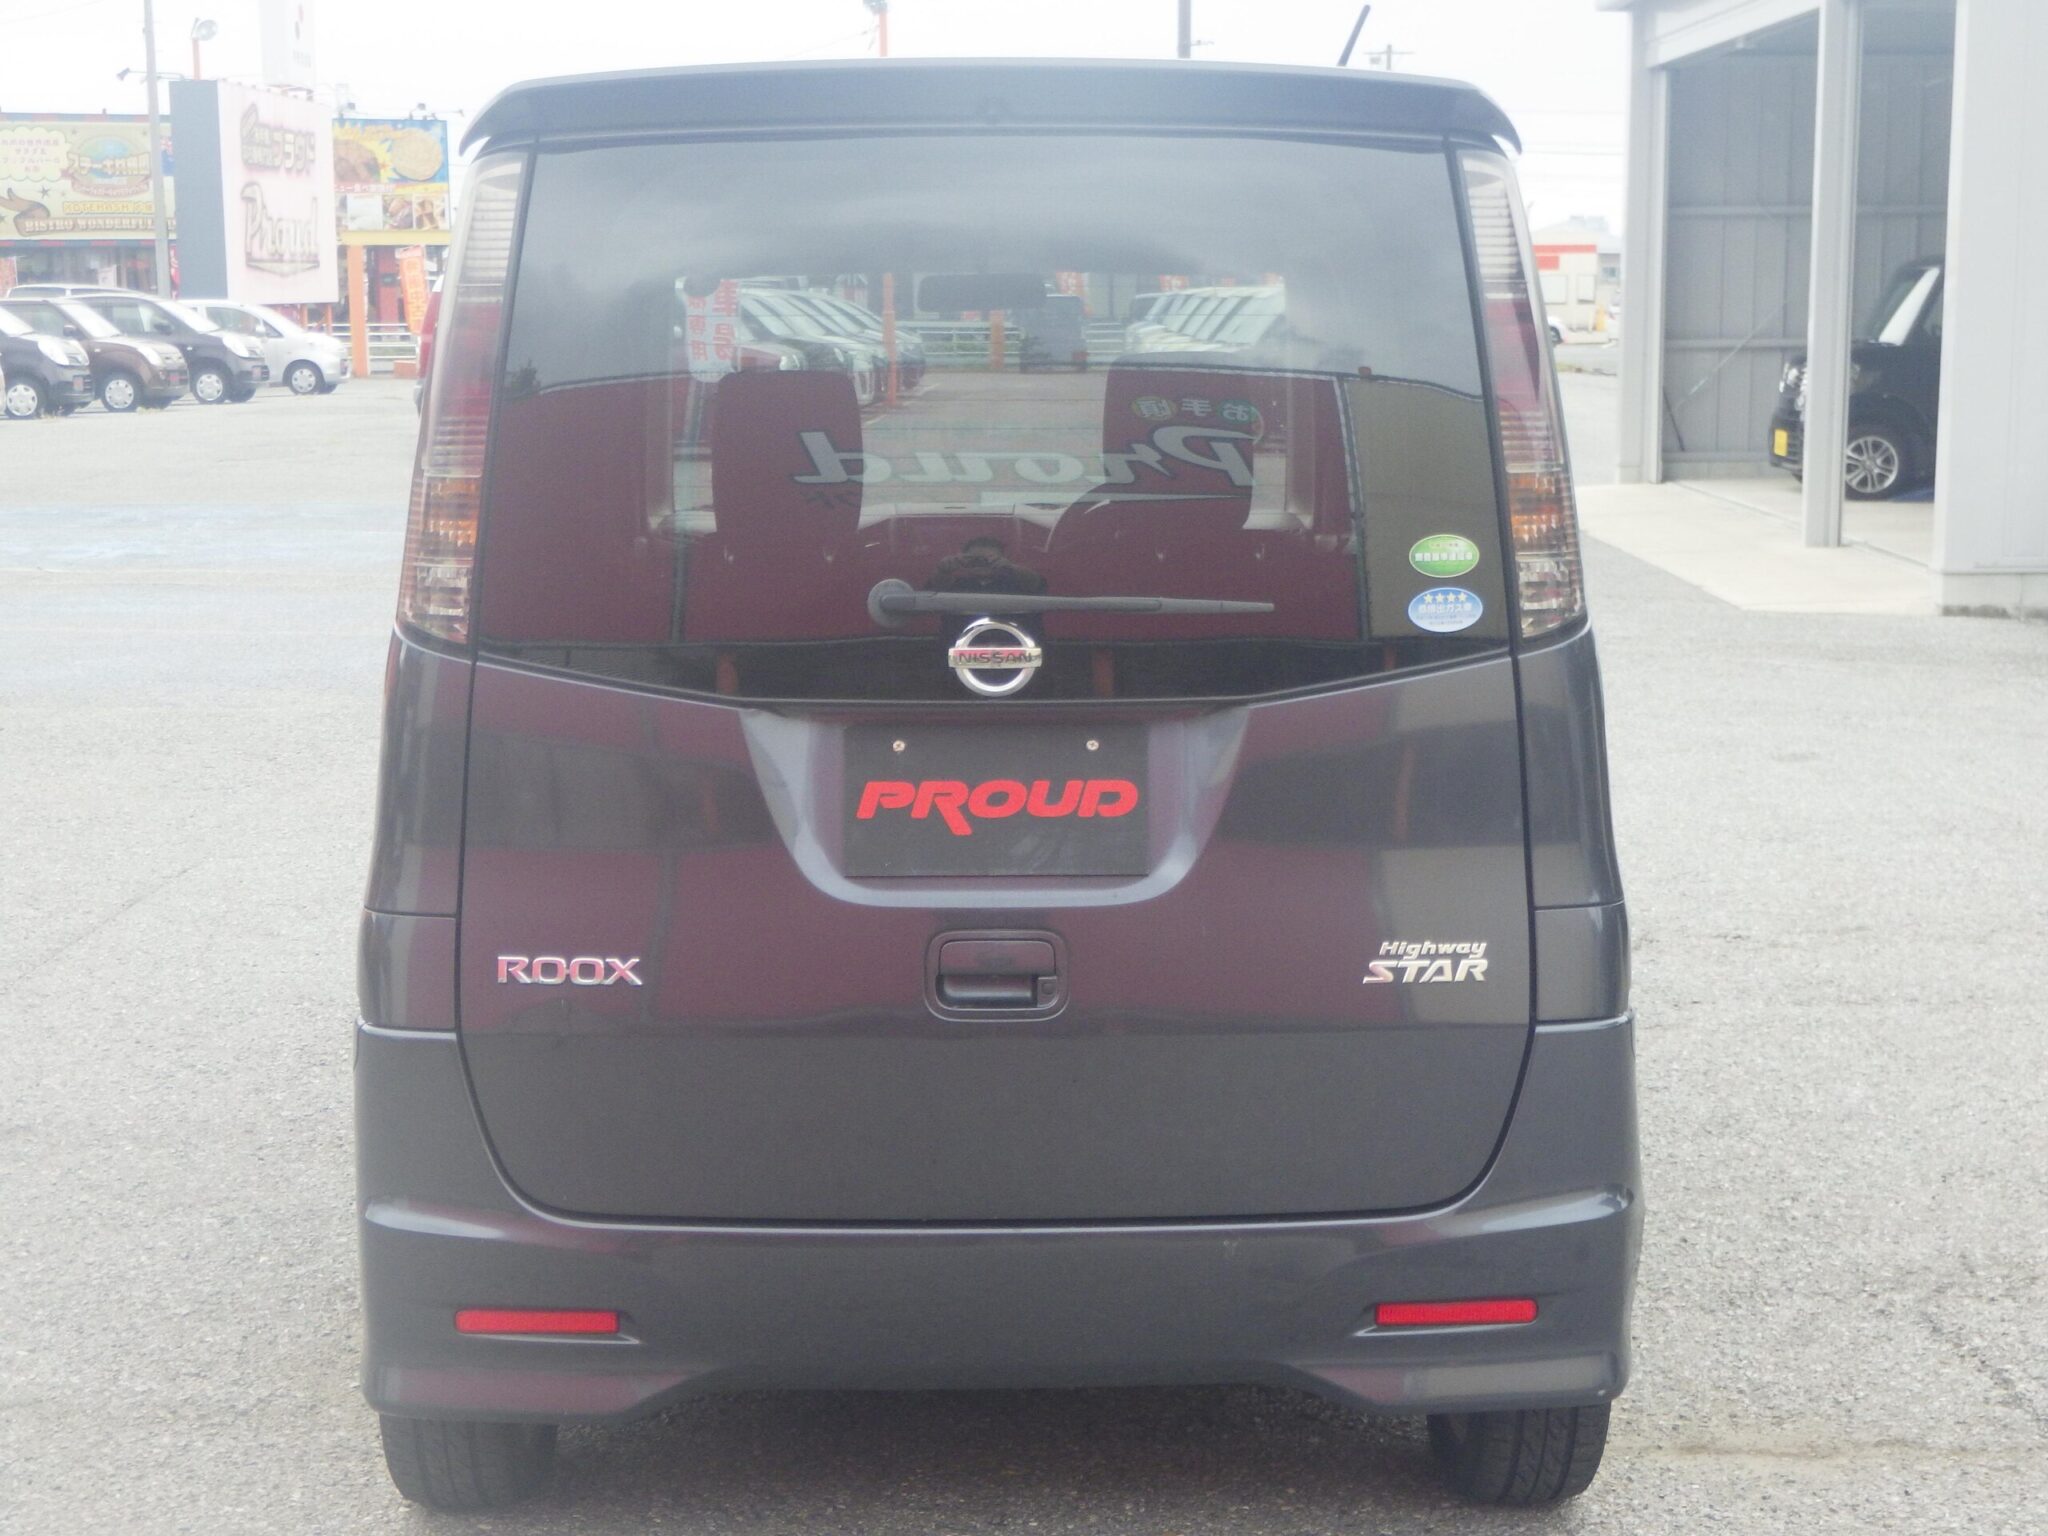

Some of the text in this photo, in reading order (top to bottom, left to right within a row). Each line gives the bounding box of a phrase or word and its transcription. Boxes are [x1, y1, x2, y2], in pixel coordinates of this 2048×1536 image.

[25, 219, 73, 232] BISTRO
[958, 651, 1033, 664] NISSAN
[856, 779, 1139, 836] PROUD
[1379, 940, 1488, 960] Highway
[497, 955, 643, 985] ROOX
[1363, 959, 1489, 985] STAR
